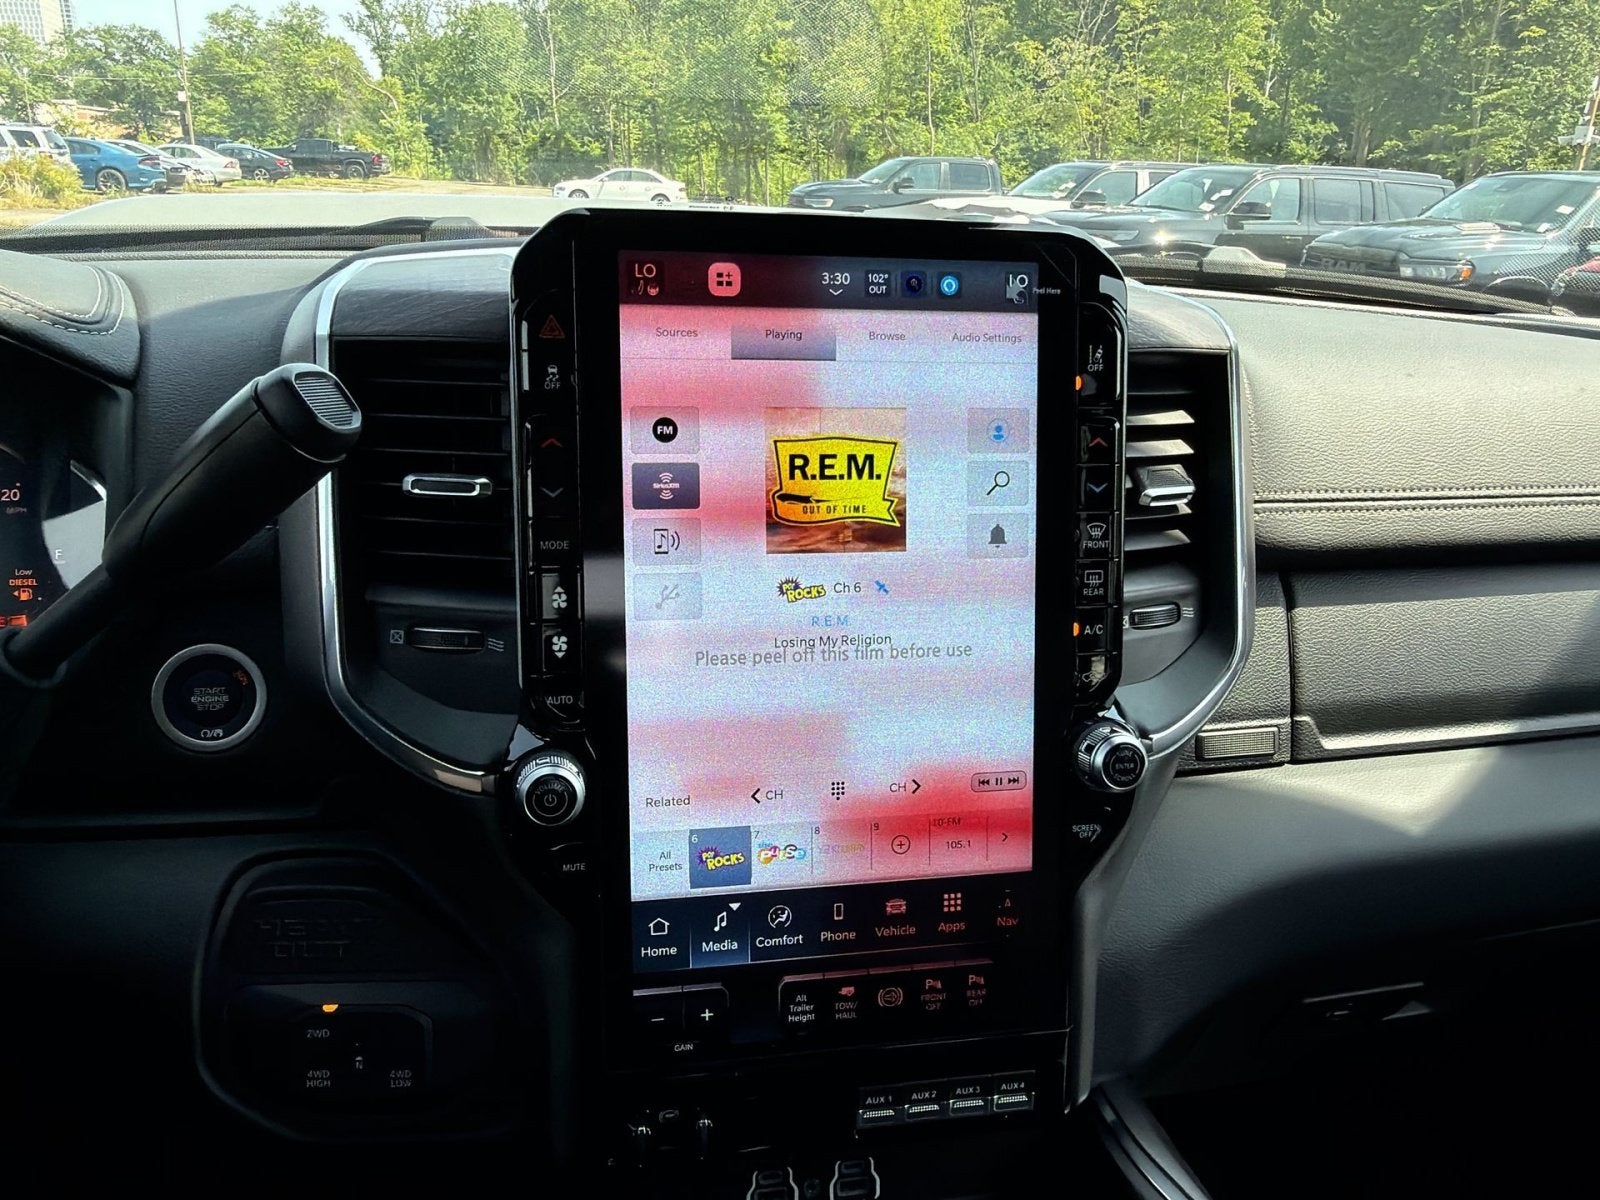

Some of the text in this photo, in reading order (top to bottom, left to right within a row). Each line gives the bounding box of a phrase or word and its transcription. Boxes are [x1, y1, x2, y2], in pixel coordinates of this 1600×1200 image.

[1321, 258, 1366, 272] RAM
[635, 263, 656, 278] LO
[821, 272, 850, 285] 3:30
[868, 285, 887, 294] OUT
[655, 327, 698, 339] Sources
[765, 328, 803, 343] Playing
[868, 330, 906, 342] Browse
[952, 332, 1022, 345] Audio Settings
[1088, 364, 1104, 372] OFF
[544, 382, 561, 390] OFF
[657, 425, 673, 434] FM
[788, 453, 881, 481] R.E.M.
[1, 489, 20, 501] 20
[802, 504, 867, 515] OUT OF TIME
[540, 541, 569, 550] MODE
[9, 578, 38, 586] DIESEL
[834, 582, 862, 594] Ch 6
[1083, 588, 1104, 596] REAR
[787, 585, 826, 602] ROCKS
[1084, 624, 1104, 635] A/C
[774, 633, 892, 648] Losing My Religion
[695, 643, 972, 668] Please peel off this film before use
[194, 687, 226, 695] START
[191, 695, 229, 703] ENGINE
[546, 696, 573, 705] AUTO
[889, 782, 907, 793] CH
[765, 789, 784, 800] CH
[645, 796, 691, 808] Related
[814, 827, 820, 835] 8
[873, 823, 880, 831] 9
[1072, 824, 1100, 832] SCREEN
[691, 834, 698, 843] 6
[754, 831, 760, 839] 7
[946, 840, 971, 849] 105.1
[659, 851, 671, 860] All
[707, 853, 745, 870] ROCKS
[562, 863, 586, 871] MUTE
[649, 862, 683, 872] Presets
[997, 916, 1018, 927] Nav
[875, 923, 916, 937] Vehicle
[938, 921, 966, 934] Apps
[820, 929, 856, 941] Phone
[756, 934, 803, 948] Comfort
[641, 944, 677, 957] Home
[702, 940, 738, 952] Media
[790, 1003, 814, 1013] Trailer
[788, 1012, 815, 1023] Height
[836, 1011, 857, 1020] HAUL
[307, 1029, 330, 1038] 2WD
[674, 1043, 693, 1052] GAIN
[356, 1061, 363, 1069] N
[307, 1069, 330, 1078] 4WD
[390, 1069, 411, 1078] 4WD
[306, 1079, 331, 1088] HIGH
[390, 1079, 411, 1088] LOW
[1001, 1083, 1018, 1091] AUX
[911, 1092, 929, 1100] AUX
[955, 1088, 973, 1096] AUX
[866, 1096, 884, 1105] AUX
